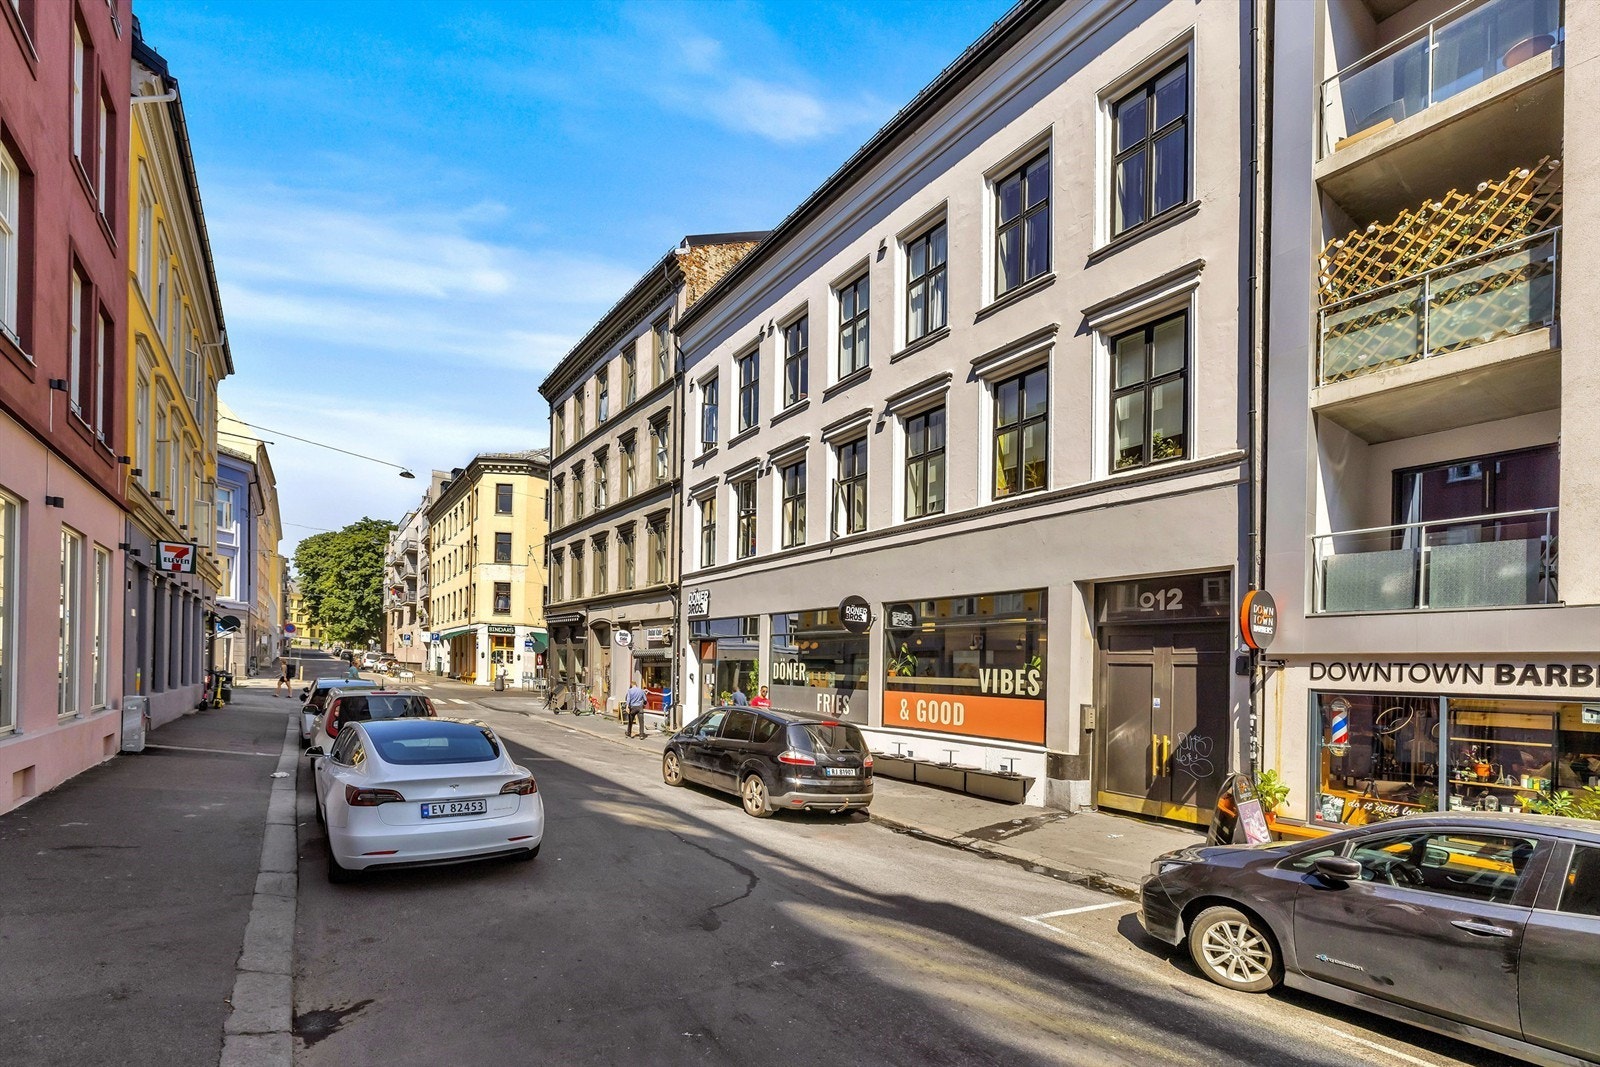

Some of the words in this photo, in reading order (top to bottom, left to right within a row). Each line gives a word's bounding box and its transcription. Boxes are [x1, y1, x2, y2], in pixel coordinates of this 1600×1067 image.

[164, 545, 190, 571] 7
[845, 605, 868, 615] DÖNER
[1253, 604, 1274, 616] DOWN
[845, 613, 864, 622] BROS.
[1253, 614, 1274, 626] TOWN
[1309, 662, 1484, 684] DOWNTOWN
[1494, 663, 1600, 688] BARB
[979, 668, 1041, 696] VIBES
[817, 693, 850, 715] FRIES
[900, 698, 910, 721] &
[916, 699, 965, 726] GOOD
[431, 803, 445, 814] EV
[450, 802, 483, 813] 82453
[1363, 802, 1373, 811] it
[1376, 804, 1399, 815] with
